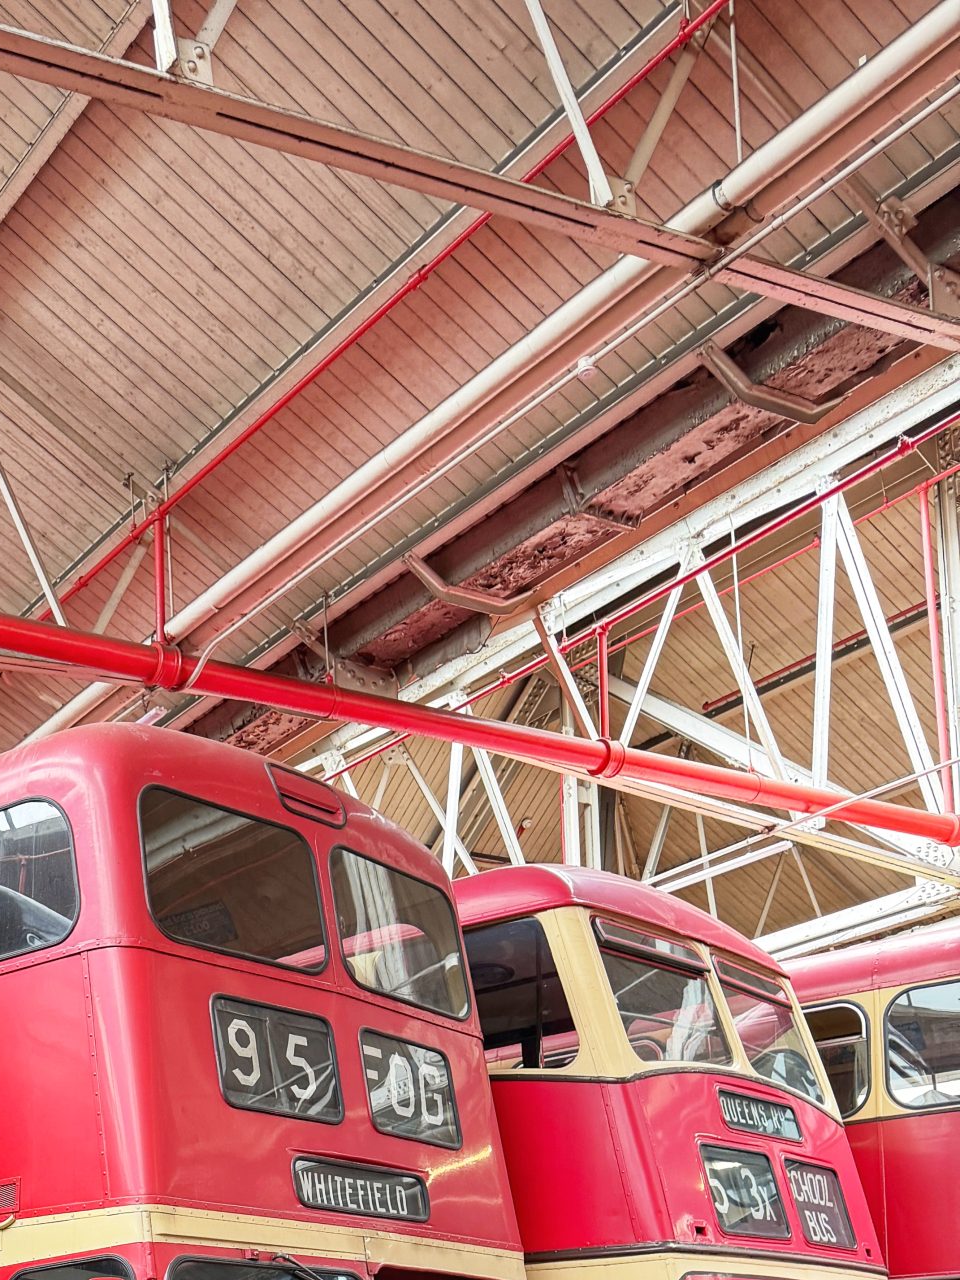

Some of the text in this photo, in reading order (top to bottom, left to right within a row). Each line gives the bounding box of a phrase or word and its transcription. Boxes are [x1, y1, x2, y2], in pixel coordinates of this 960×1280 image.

[719, 1096, 768, 1127] QUEENS
[298, 1170, 408, 1216] WHITEFIELD
[804, 1210, 837, 1243] BUS
